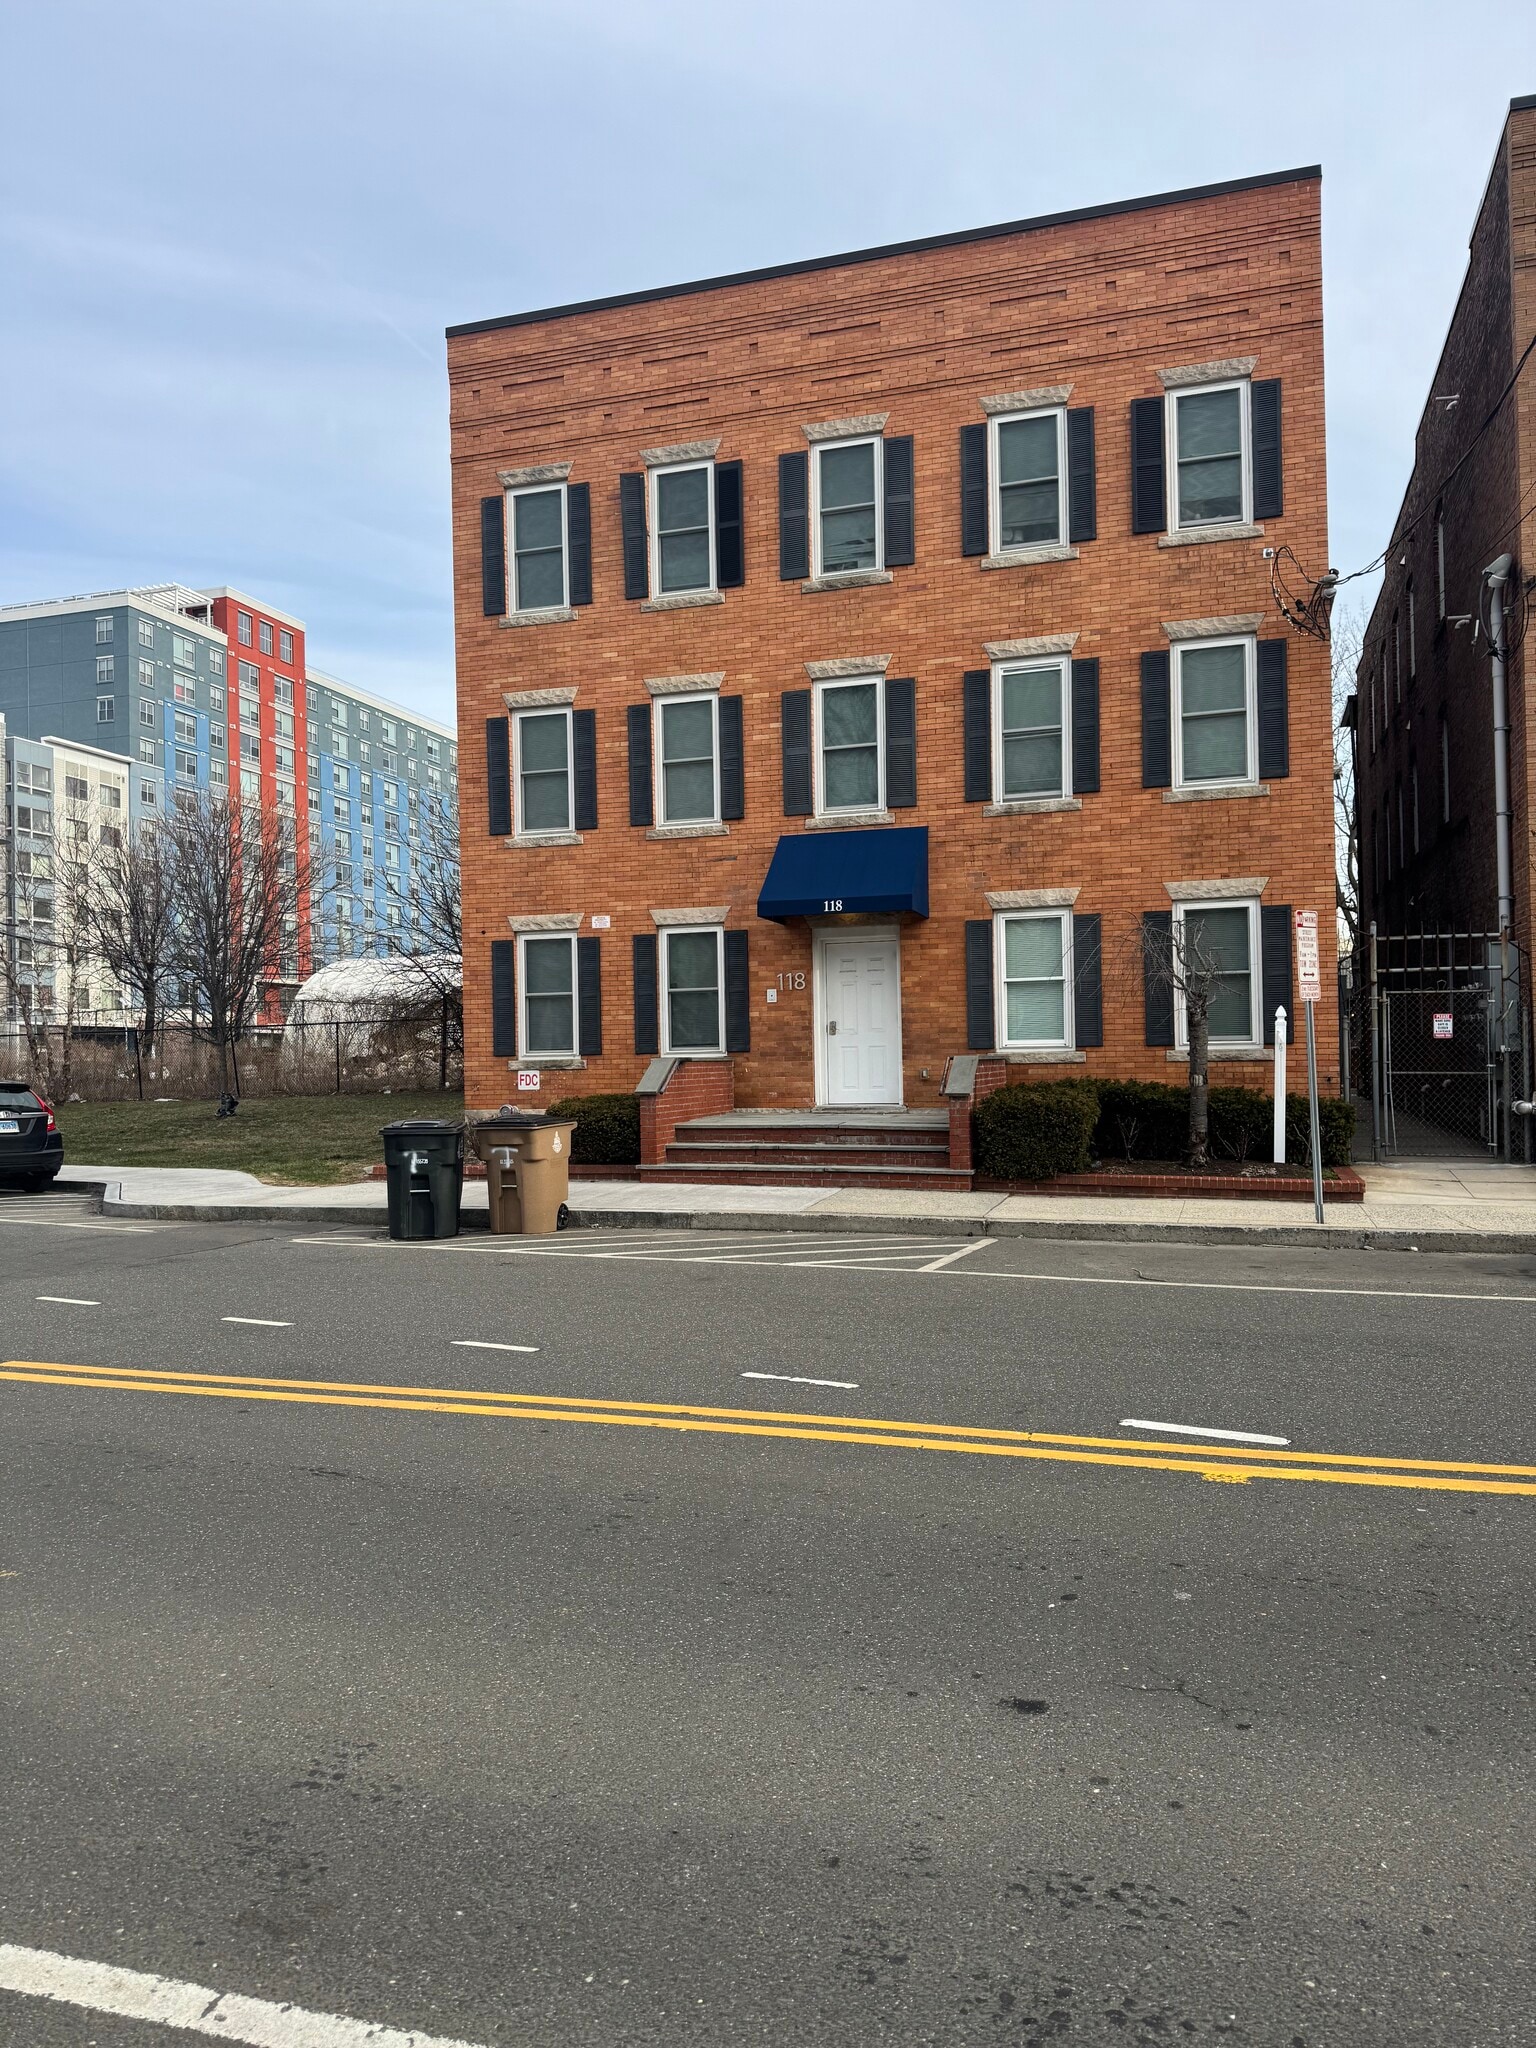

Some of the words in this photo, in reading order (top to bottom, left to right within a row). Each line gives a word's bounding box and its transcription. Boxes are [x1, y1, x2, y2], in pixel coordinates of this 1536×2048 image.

[823, 899, 843, 912] 118
[777, 972, 806, 991] 118
[519, 1073, 538, 1086] FDC
